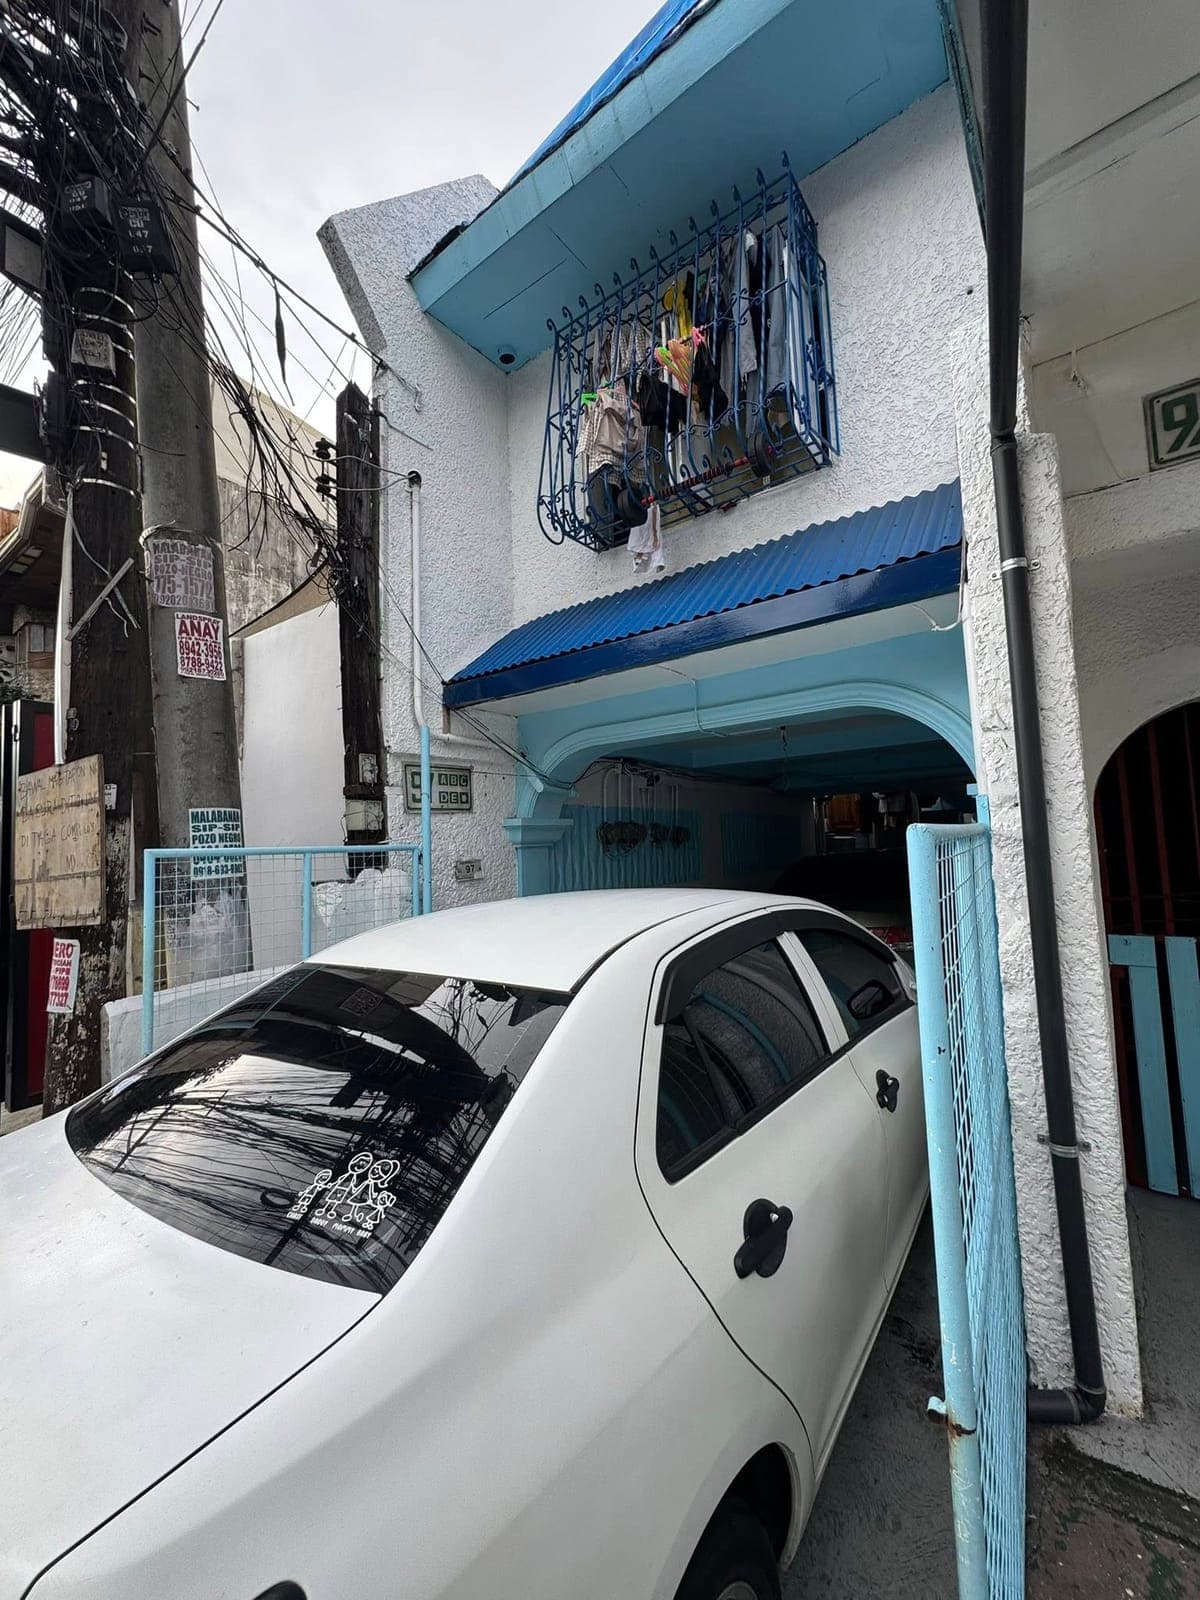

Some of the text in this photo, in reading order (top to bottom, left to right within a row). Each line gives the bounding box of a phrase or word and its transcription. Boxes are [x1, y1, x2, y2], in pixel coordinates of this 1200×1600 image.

[178, 620, 219, 640] ANAY
[179, 640, 222, 660] 8942-3956
[180, 656, 223, 672] 8788-9422
[438, 773, 469, 787] ABC
[191, 824, 240, 833] SIP-SIP
[192, 834, 217, 845] POZO
[465, 864, 475, 873] 97
